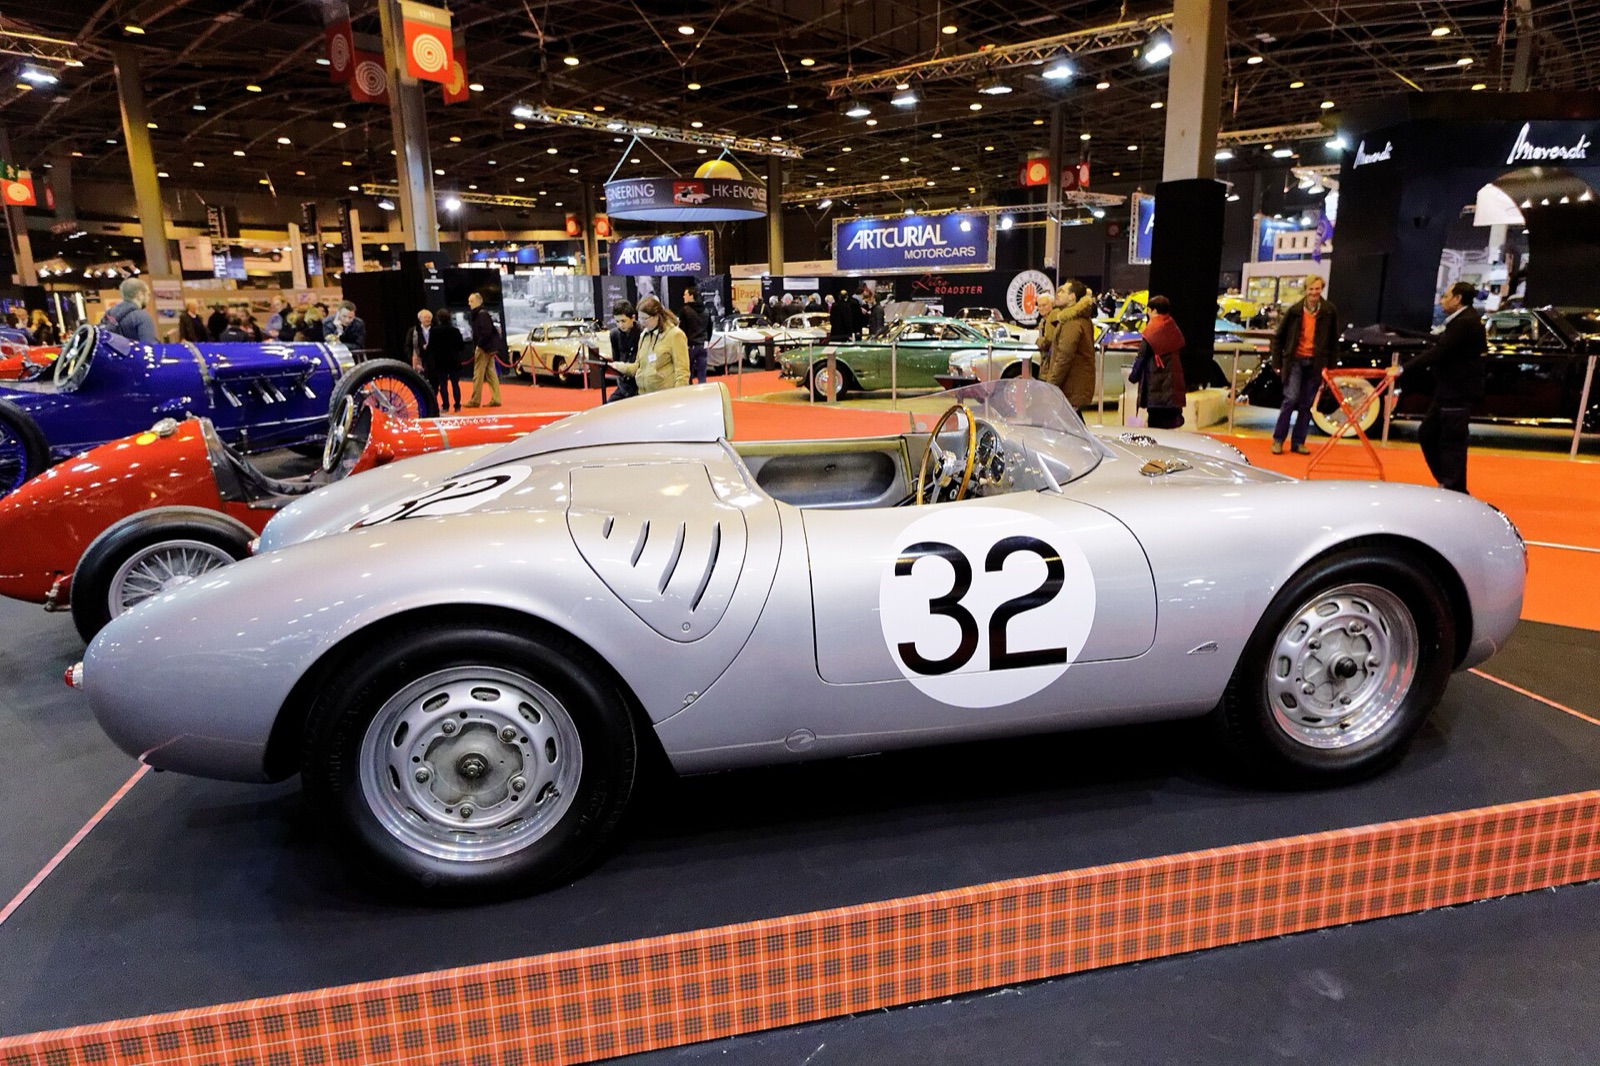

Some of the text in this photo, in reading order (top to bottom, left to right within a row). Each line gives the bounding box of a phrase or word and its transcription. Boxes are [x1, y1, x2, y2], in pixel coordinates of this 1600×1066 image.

[207, 205, 229, 254] GLLERY
[904, 246, 976, 259] MOTORCARS
[654, 262, 702, 273] MOTORCARS
[934, 285, 983, 295] ROADSTER
[894, 535, 1067, 675] 32
